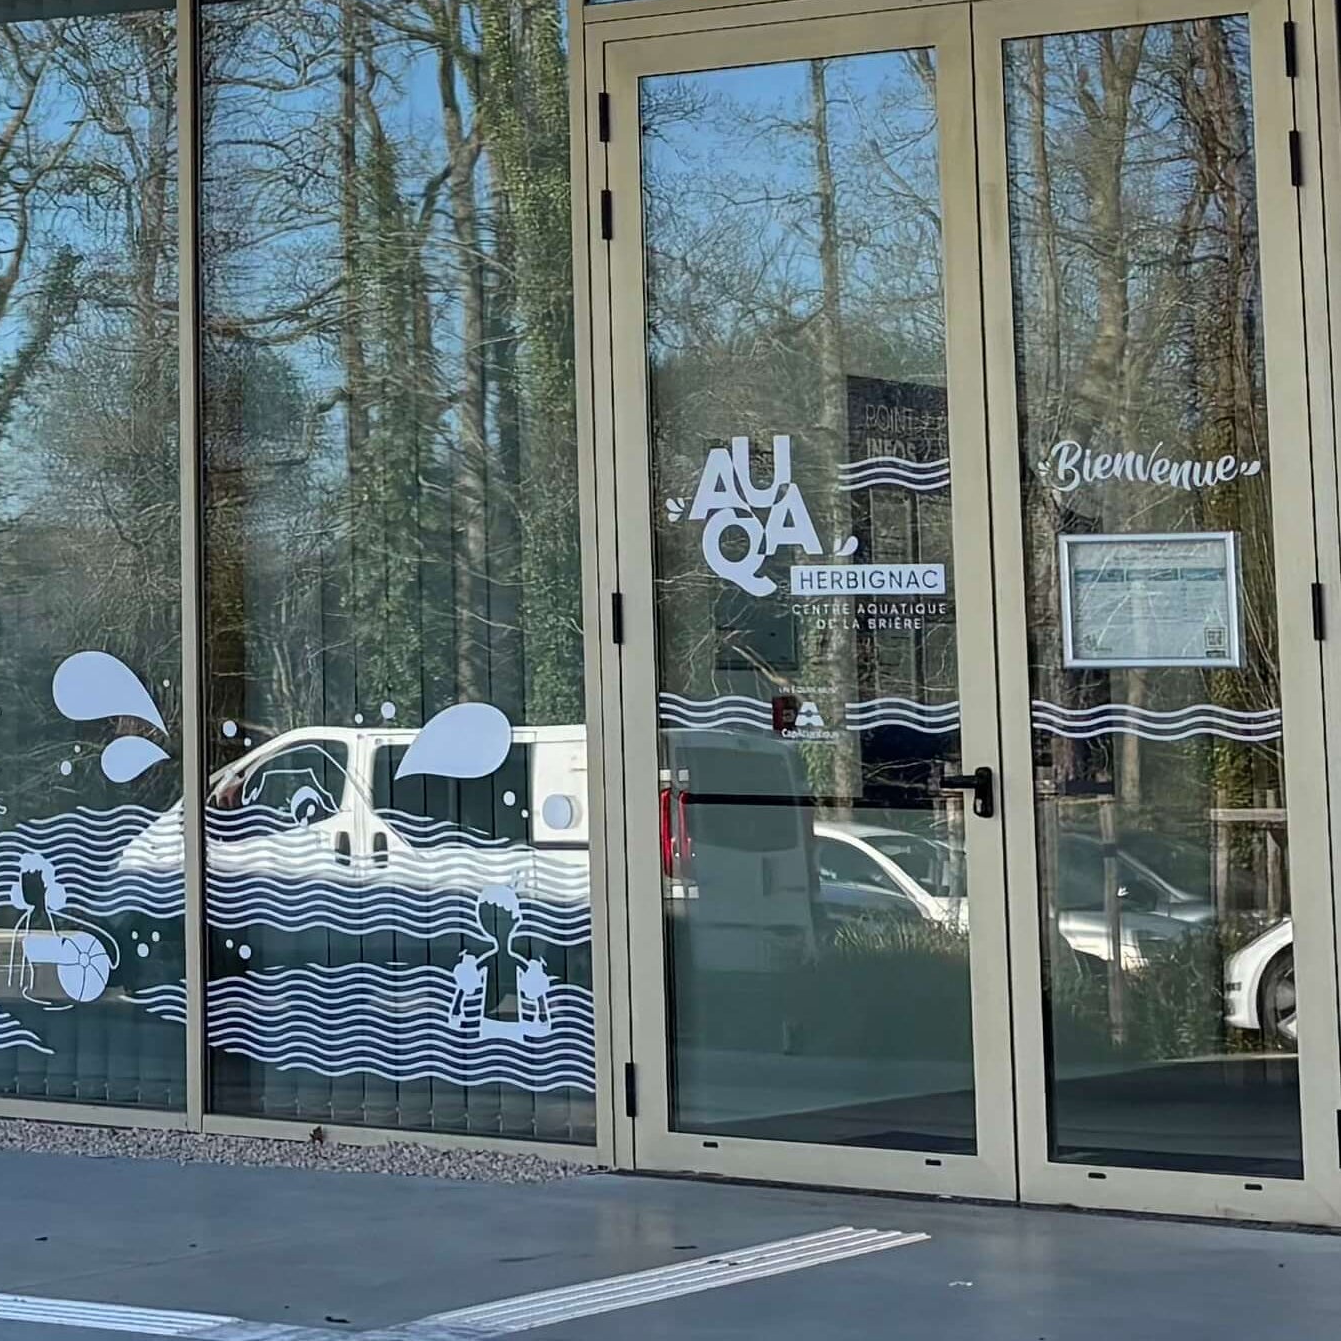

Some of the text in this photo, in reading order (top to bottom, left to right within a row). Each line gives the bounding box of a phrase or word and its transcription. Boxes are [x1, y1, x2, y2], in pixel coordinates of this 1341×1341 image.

[1050, 440, 1239, 492] Bienvenue
[800, 569, 939, 590] HERBIGNAC
[791, 603, 948, 615] CENTRE AQUATIQUE
[817, 615, 923, 630] DE LA BRIÈRE
